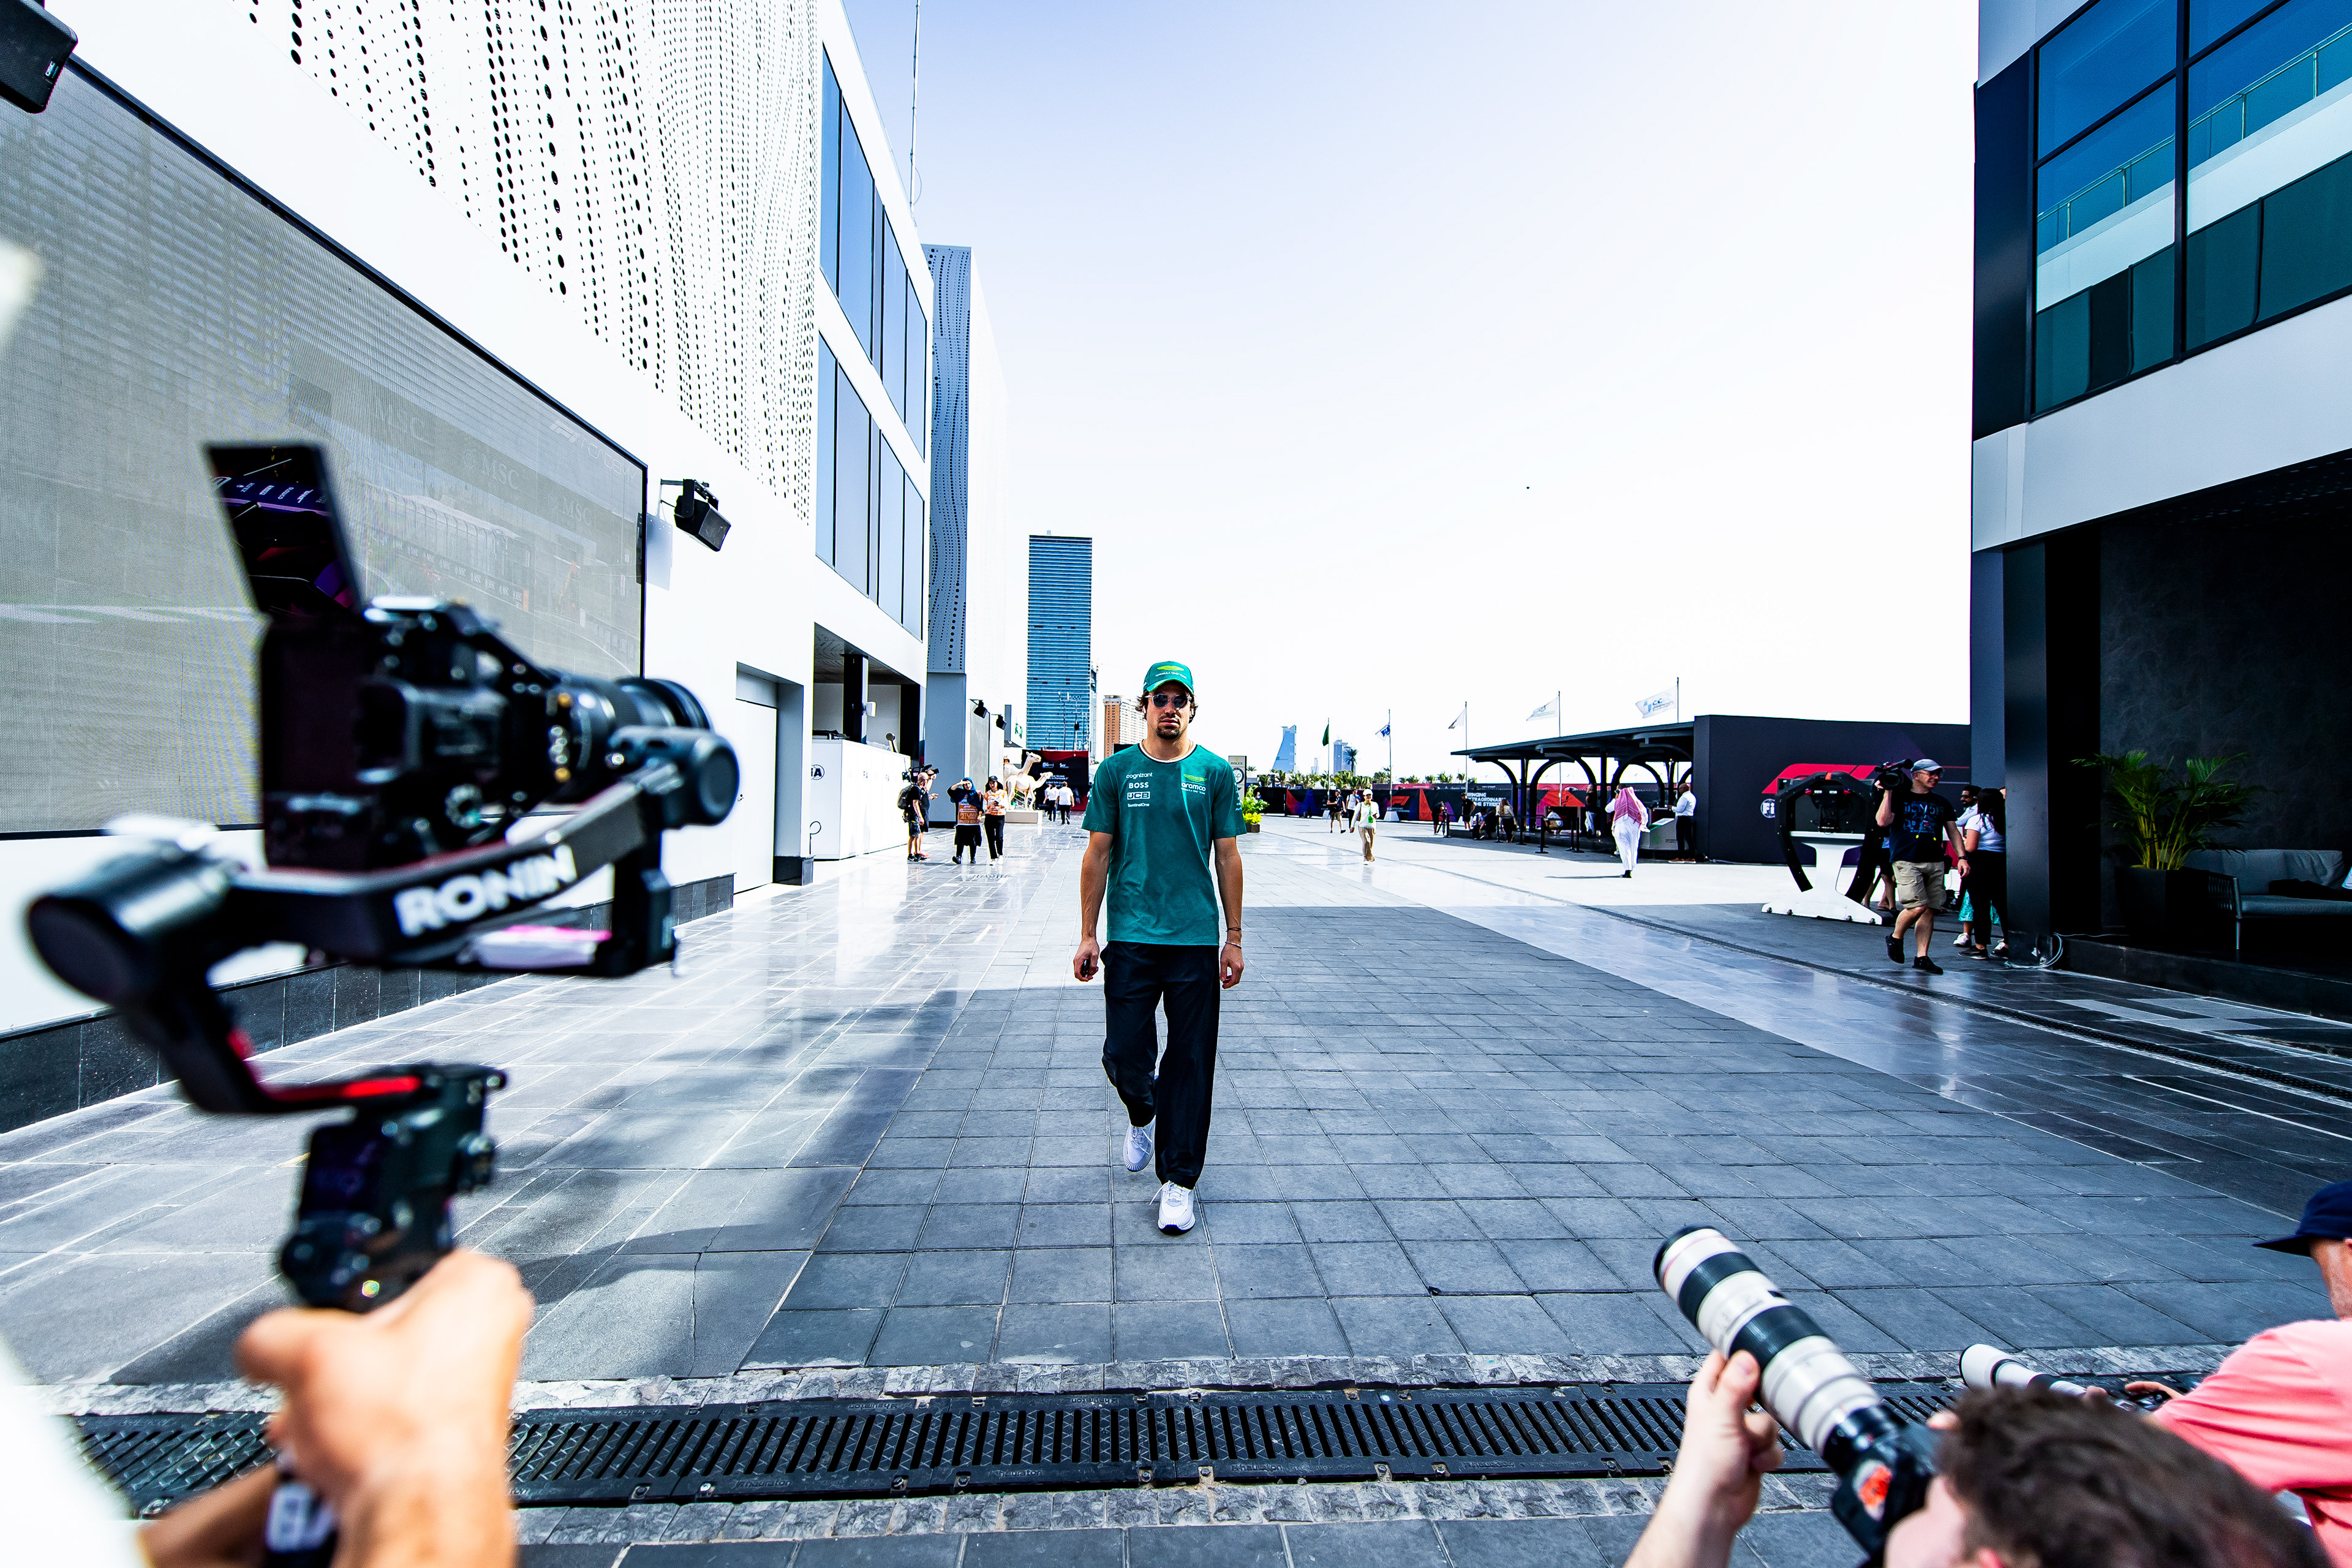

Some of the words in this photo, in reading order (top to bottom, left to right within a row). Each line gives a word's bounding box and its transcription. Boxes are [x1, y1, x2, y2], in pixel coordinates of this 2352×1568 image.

[481, 453, 519, 489] MSC
[1181, 782, 1206, 791] aramco
[392, 844, 577, 937] RONIN
